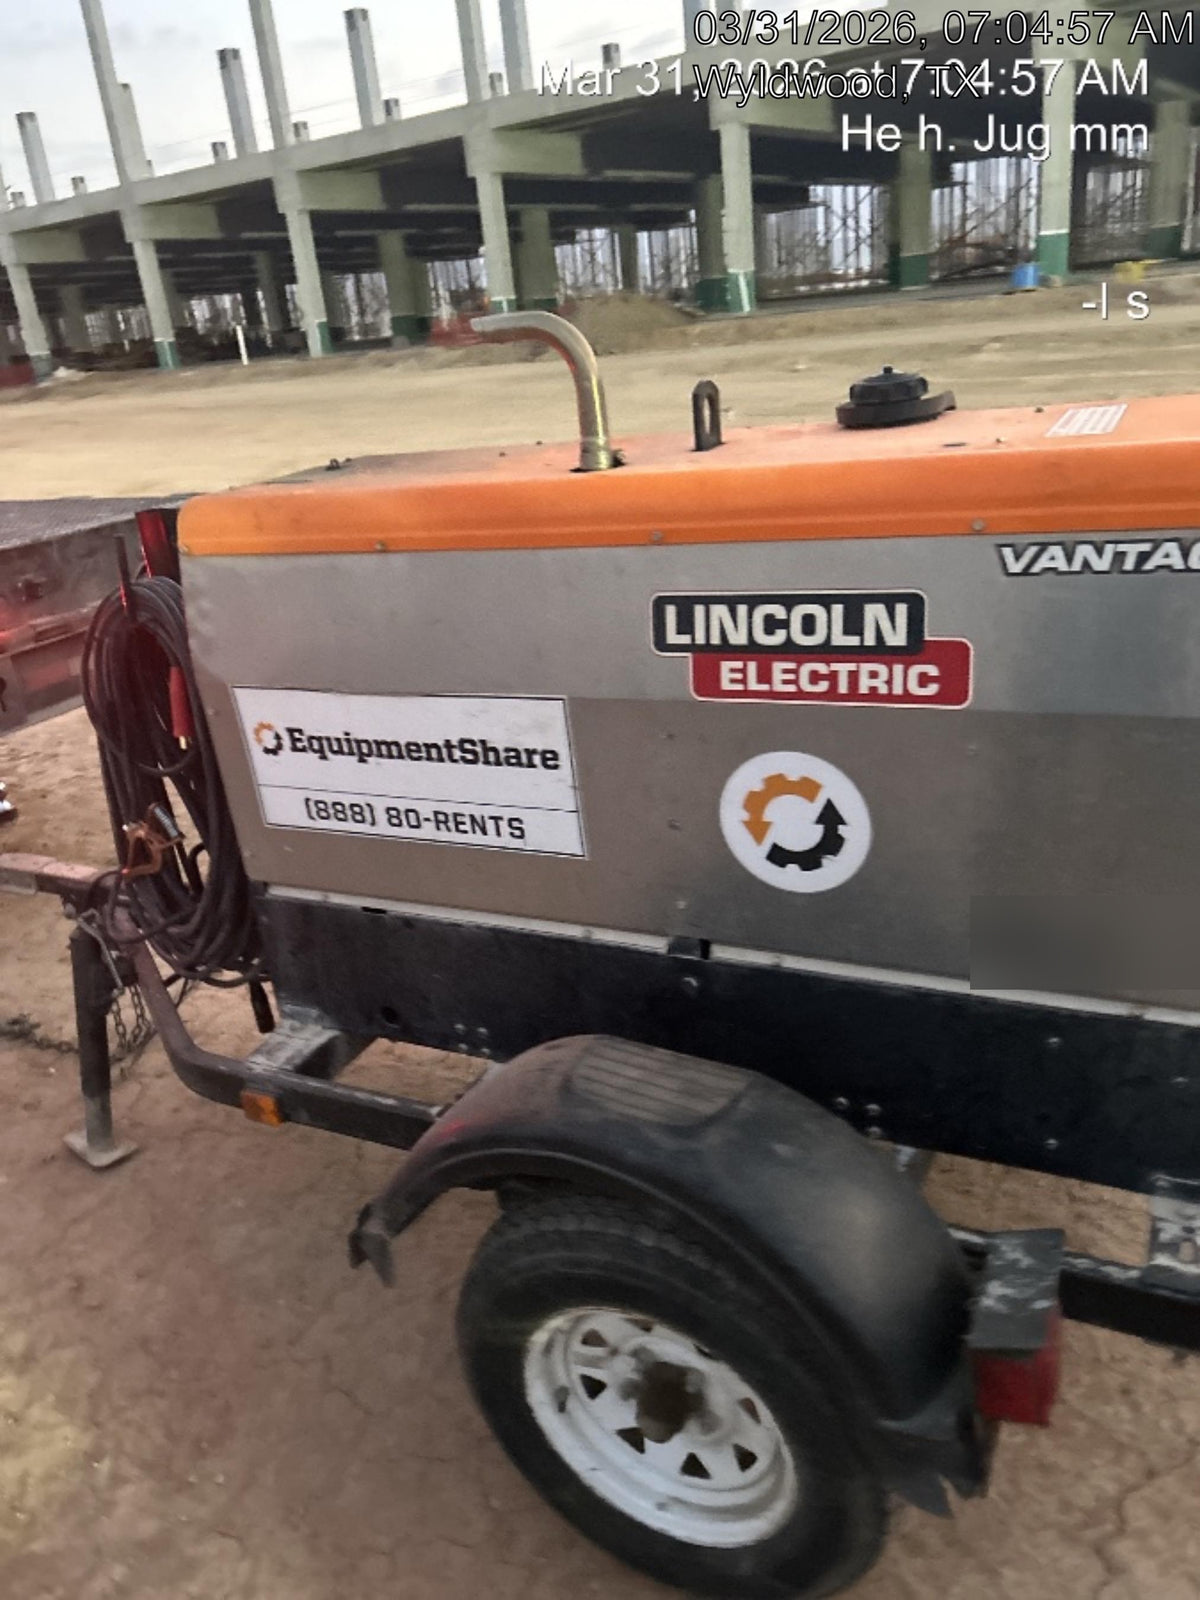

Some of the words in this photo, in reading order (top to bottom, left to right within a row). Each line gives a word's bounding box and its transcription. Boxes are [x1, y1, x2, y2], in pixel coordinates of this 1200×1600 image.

[664, 602, 909, 647] LINCOLN
[719, 660, 940, 697] ELECTRIC
[285, 727, 561, 771] EquipmentShare
[304, 797, 377, 827] (888)
[385, 806, 527, 840] 80-RENTS
